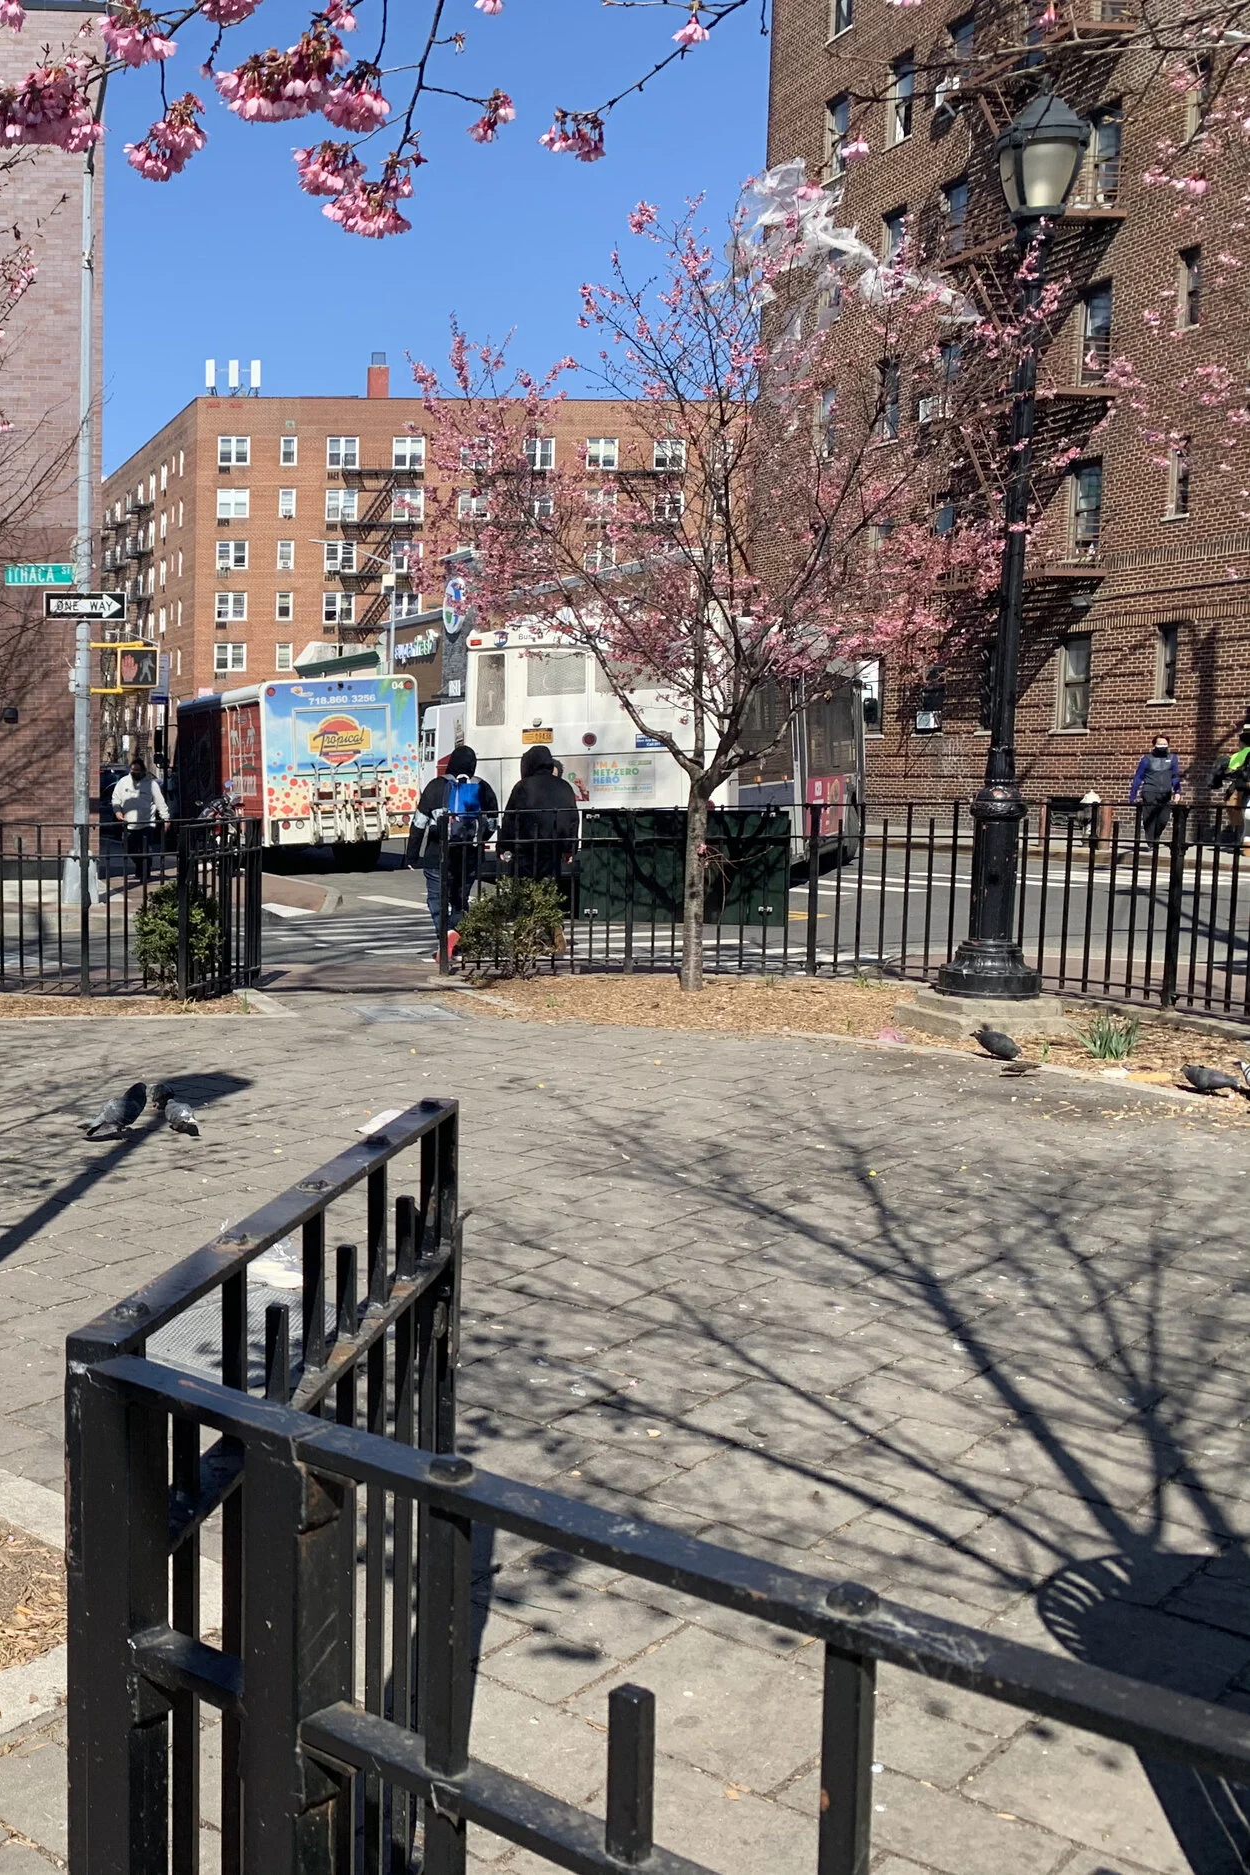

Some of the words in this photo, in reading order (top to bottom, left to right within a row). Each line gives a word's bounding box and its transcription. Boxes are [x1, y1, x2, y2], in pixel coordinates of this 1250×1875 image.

[8, 566, 55, 583] ITHACA
[61, 566, 71, 576] ST
[56, 600, 79, 612] ONE
[90, 601, 113, 612] WAY
[391, 681, 404, 690] 04
[313, 727, 365, 757] Tropical
[592, 768, 640, 776] NET-ZERO
[592, 776, 620, 784] HERO
